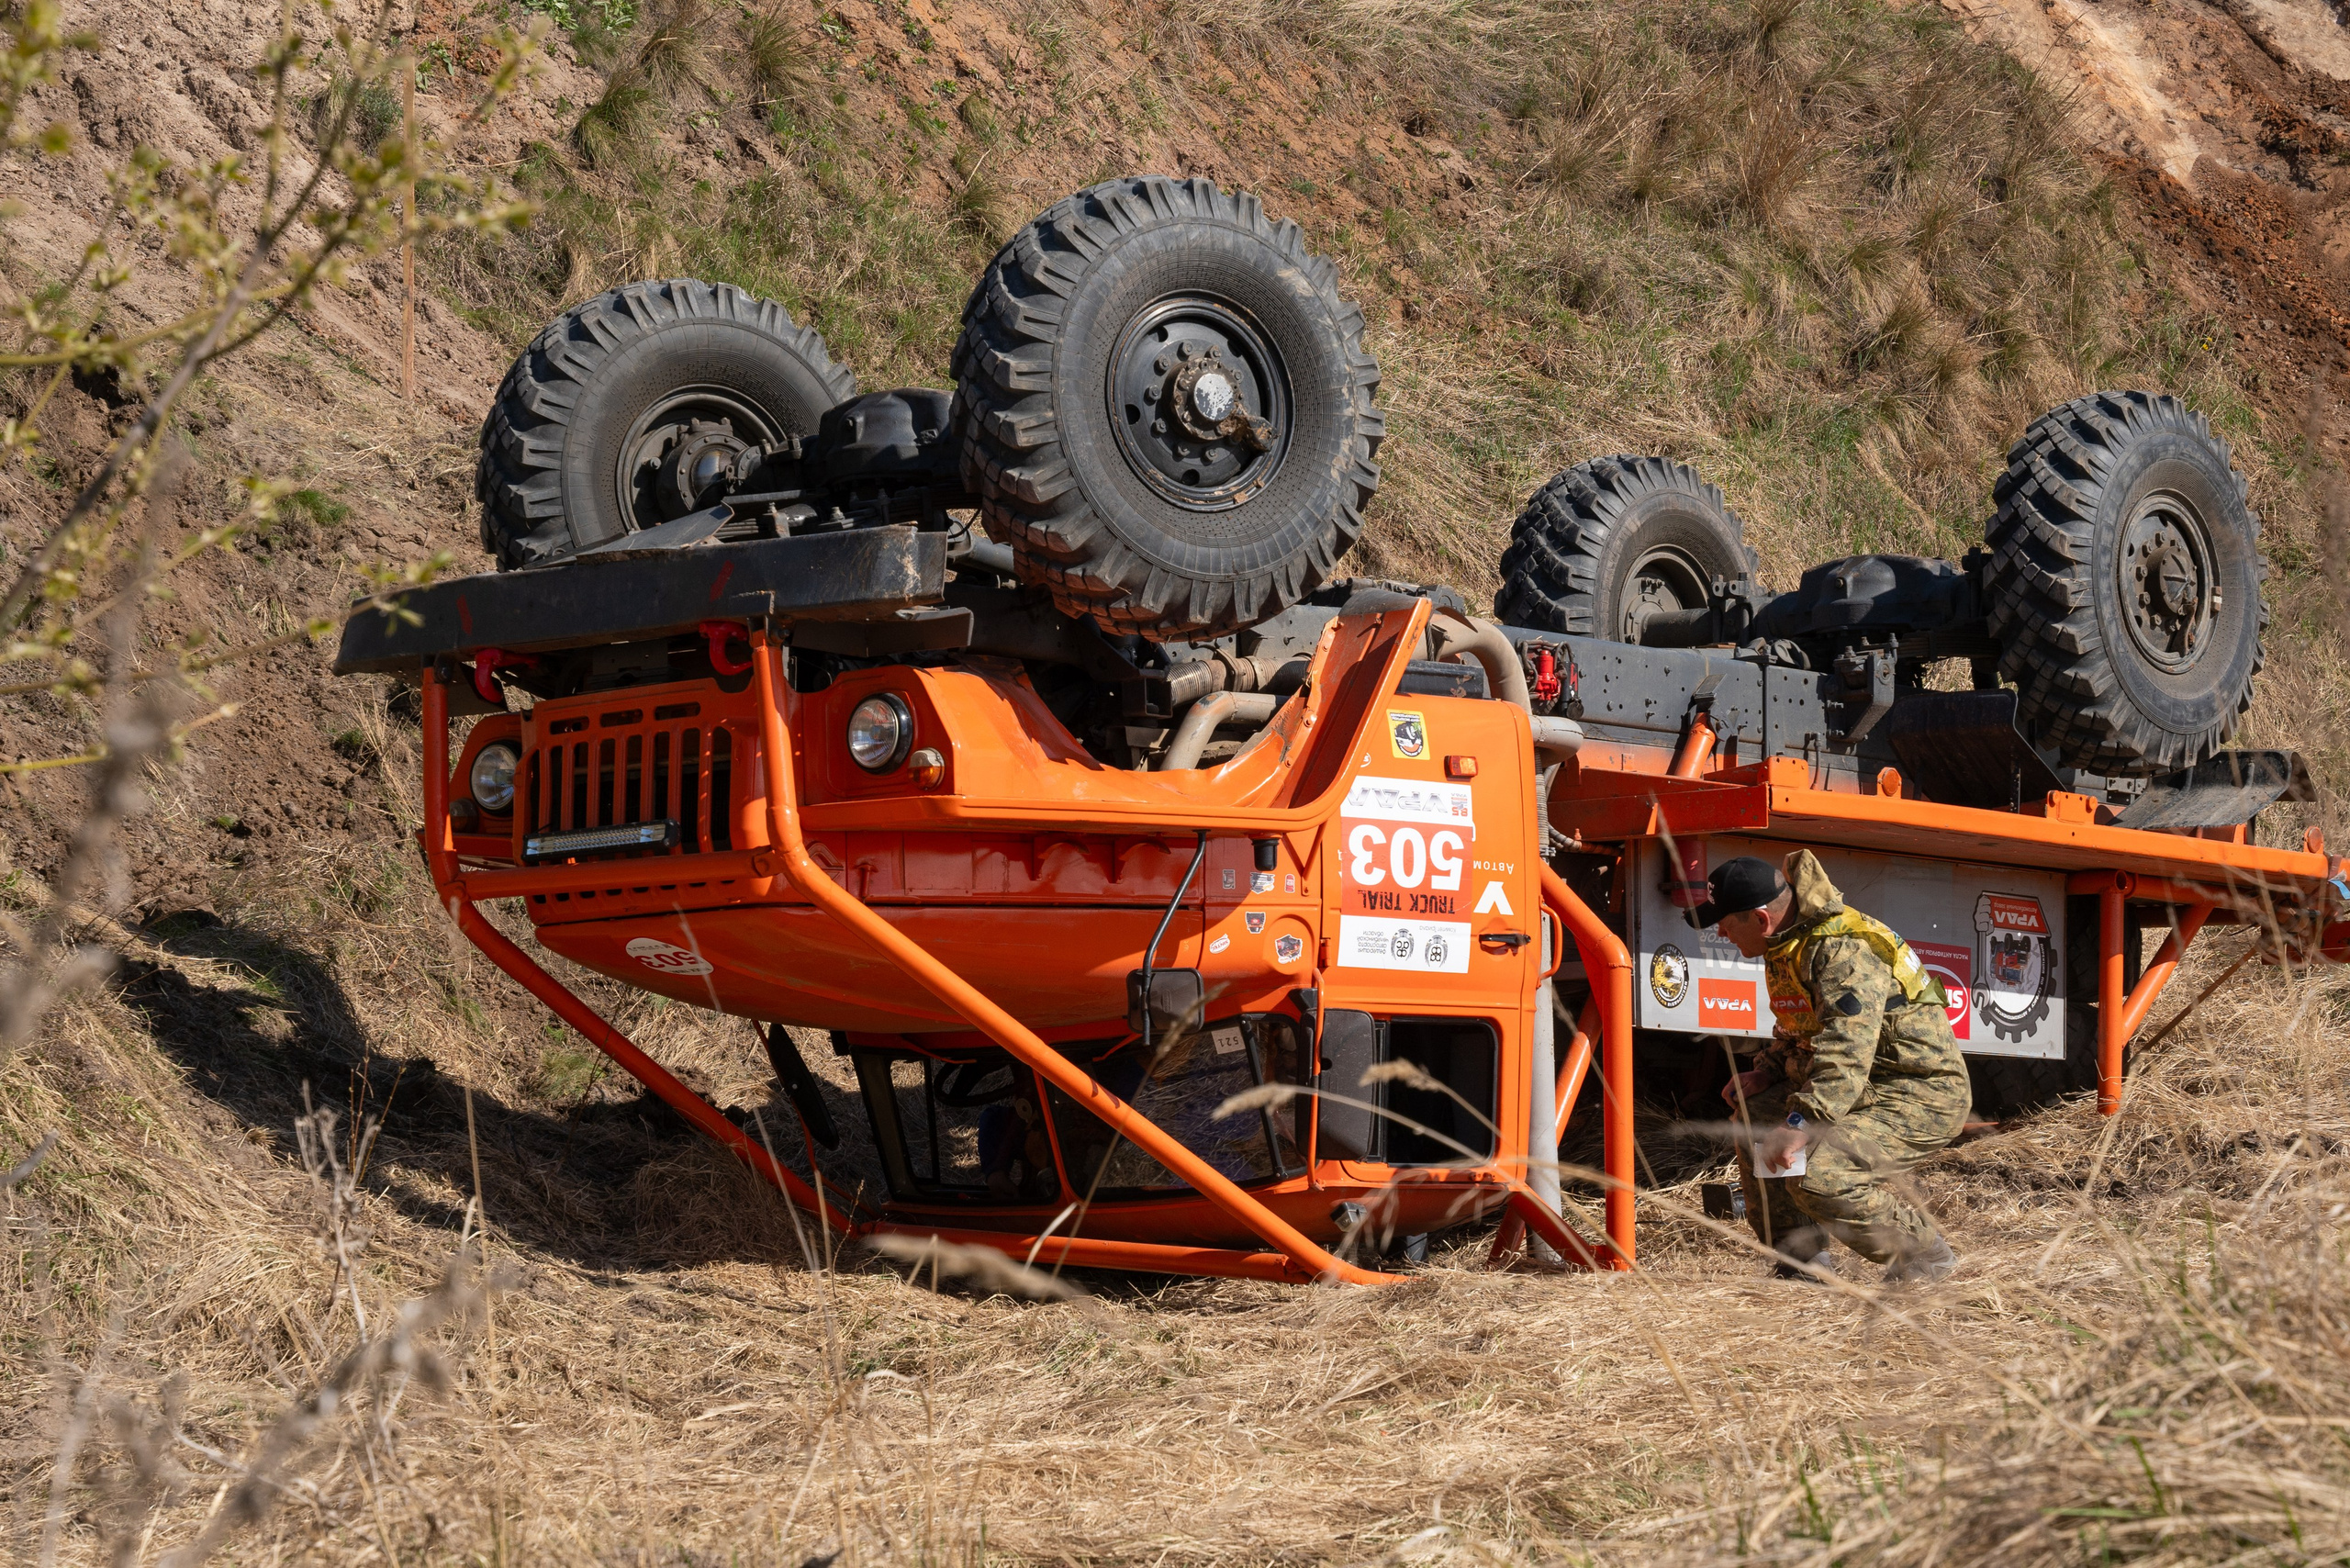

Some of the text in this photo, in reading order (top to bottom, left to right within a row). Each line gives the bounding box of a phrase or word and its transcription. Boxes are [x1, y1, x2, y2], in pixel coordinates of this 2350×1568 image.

[1347, 788, 1448, 814] УРАЛ
[1451, 806, 1469, 817] 85
[1348, 823, 1465, 891] 503
[1357, 890, 1456, 914] TRUCK TRIAL
[1994, 911, 2039, 927] УРАЛ
[1700, 932, 1732, 944] OTOR
[633, 951, 699, 969] 503
[1925, 950, 1953, 959] АНТИФРИЗЫ
[1702, 997, 1752, 1013] УРАЛ
[1217, 1036, 1239, 1047] 521
